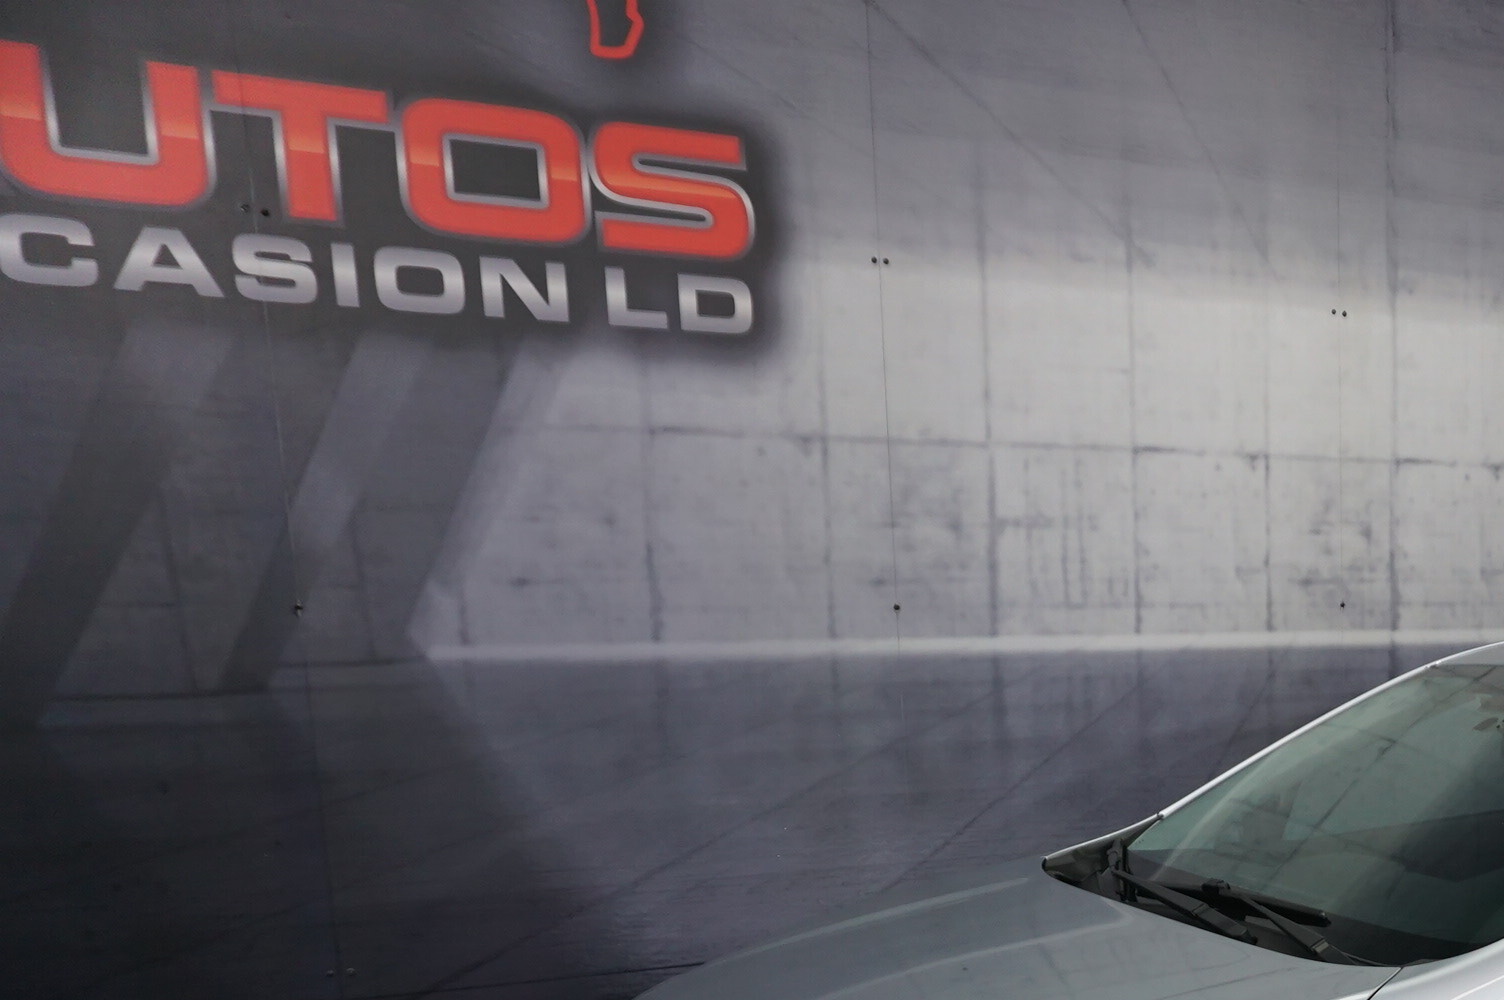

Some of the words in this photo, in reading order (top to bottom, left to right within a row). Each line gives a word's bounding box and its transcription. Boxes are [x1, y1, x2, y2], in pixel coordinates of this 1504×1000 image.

[0, 38, 755, 260] UTOS
[0, 212, 570, 323] CASION
[604, 265, 753, 335] LD
